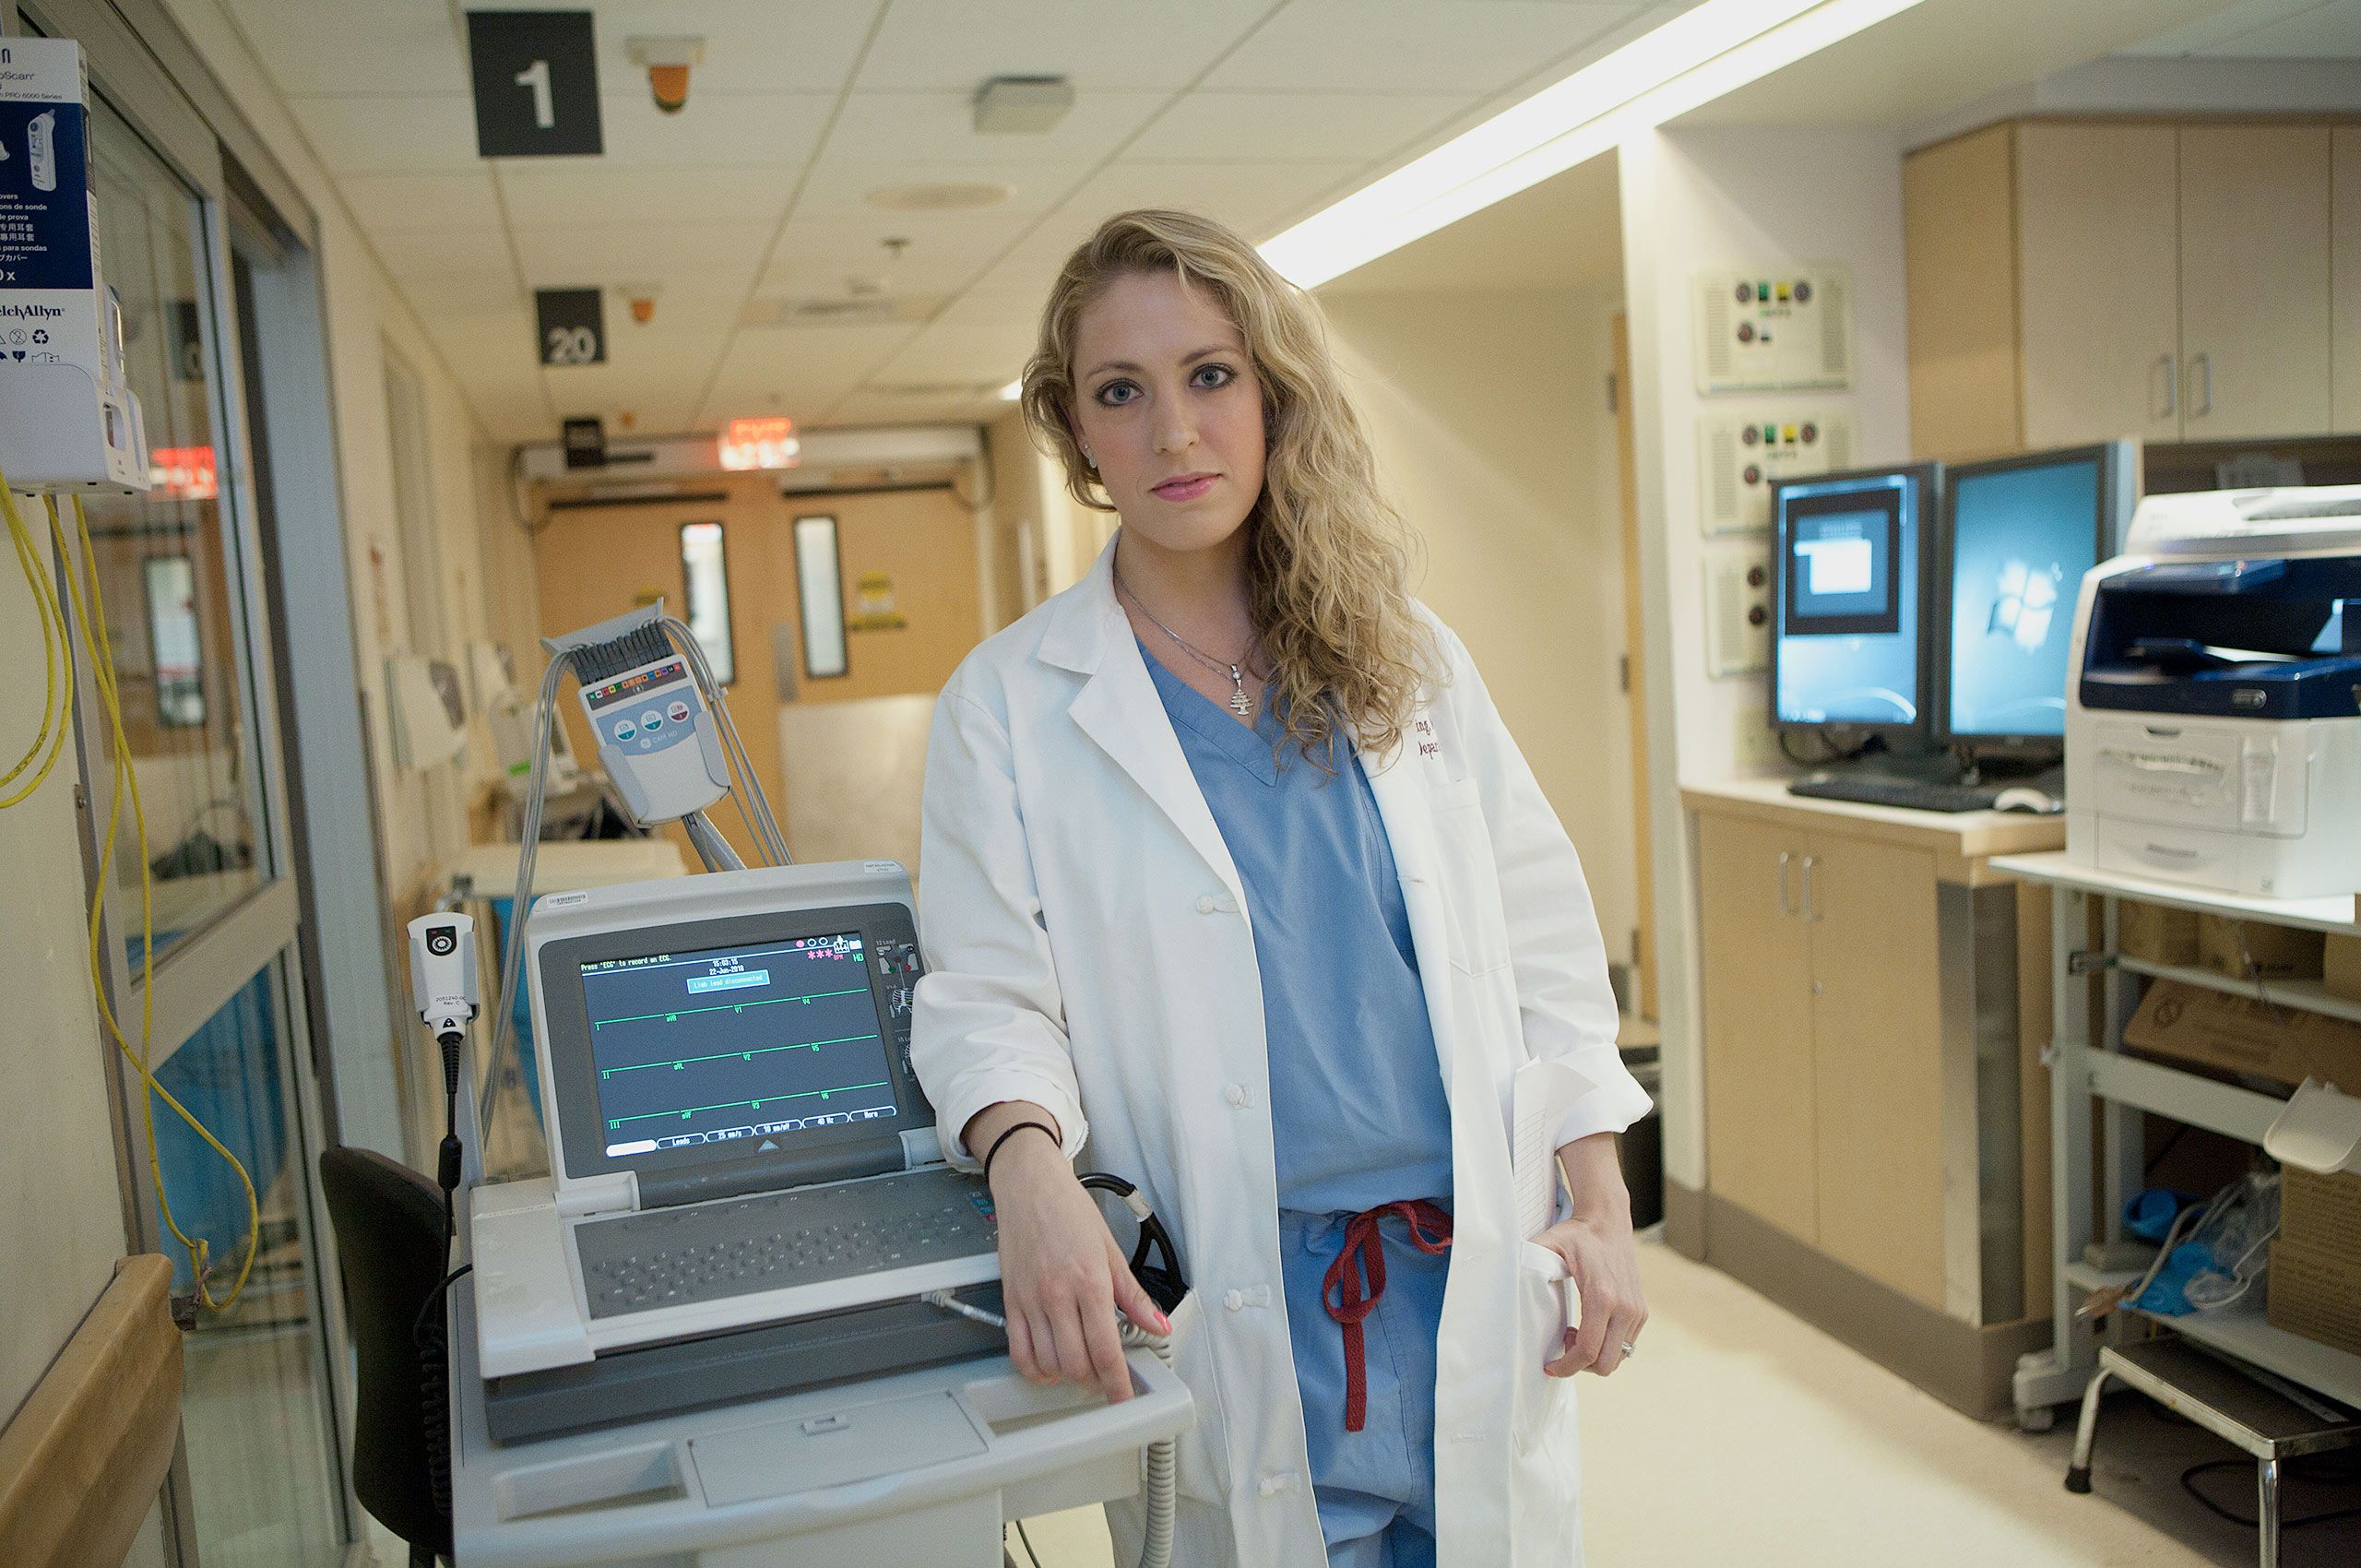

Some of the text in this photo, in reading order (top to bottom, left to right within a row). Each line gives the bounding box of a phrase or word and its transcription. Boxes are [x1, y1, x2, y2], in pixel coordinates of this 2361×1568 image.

[515, 60, 555, 129] 1
[0, 304, 63, 321] lchAllyn
[548, 327, 598, 364] 20
[628, 957, 648, 966] record
[725, 974, 764, 985] disconnected
